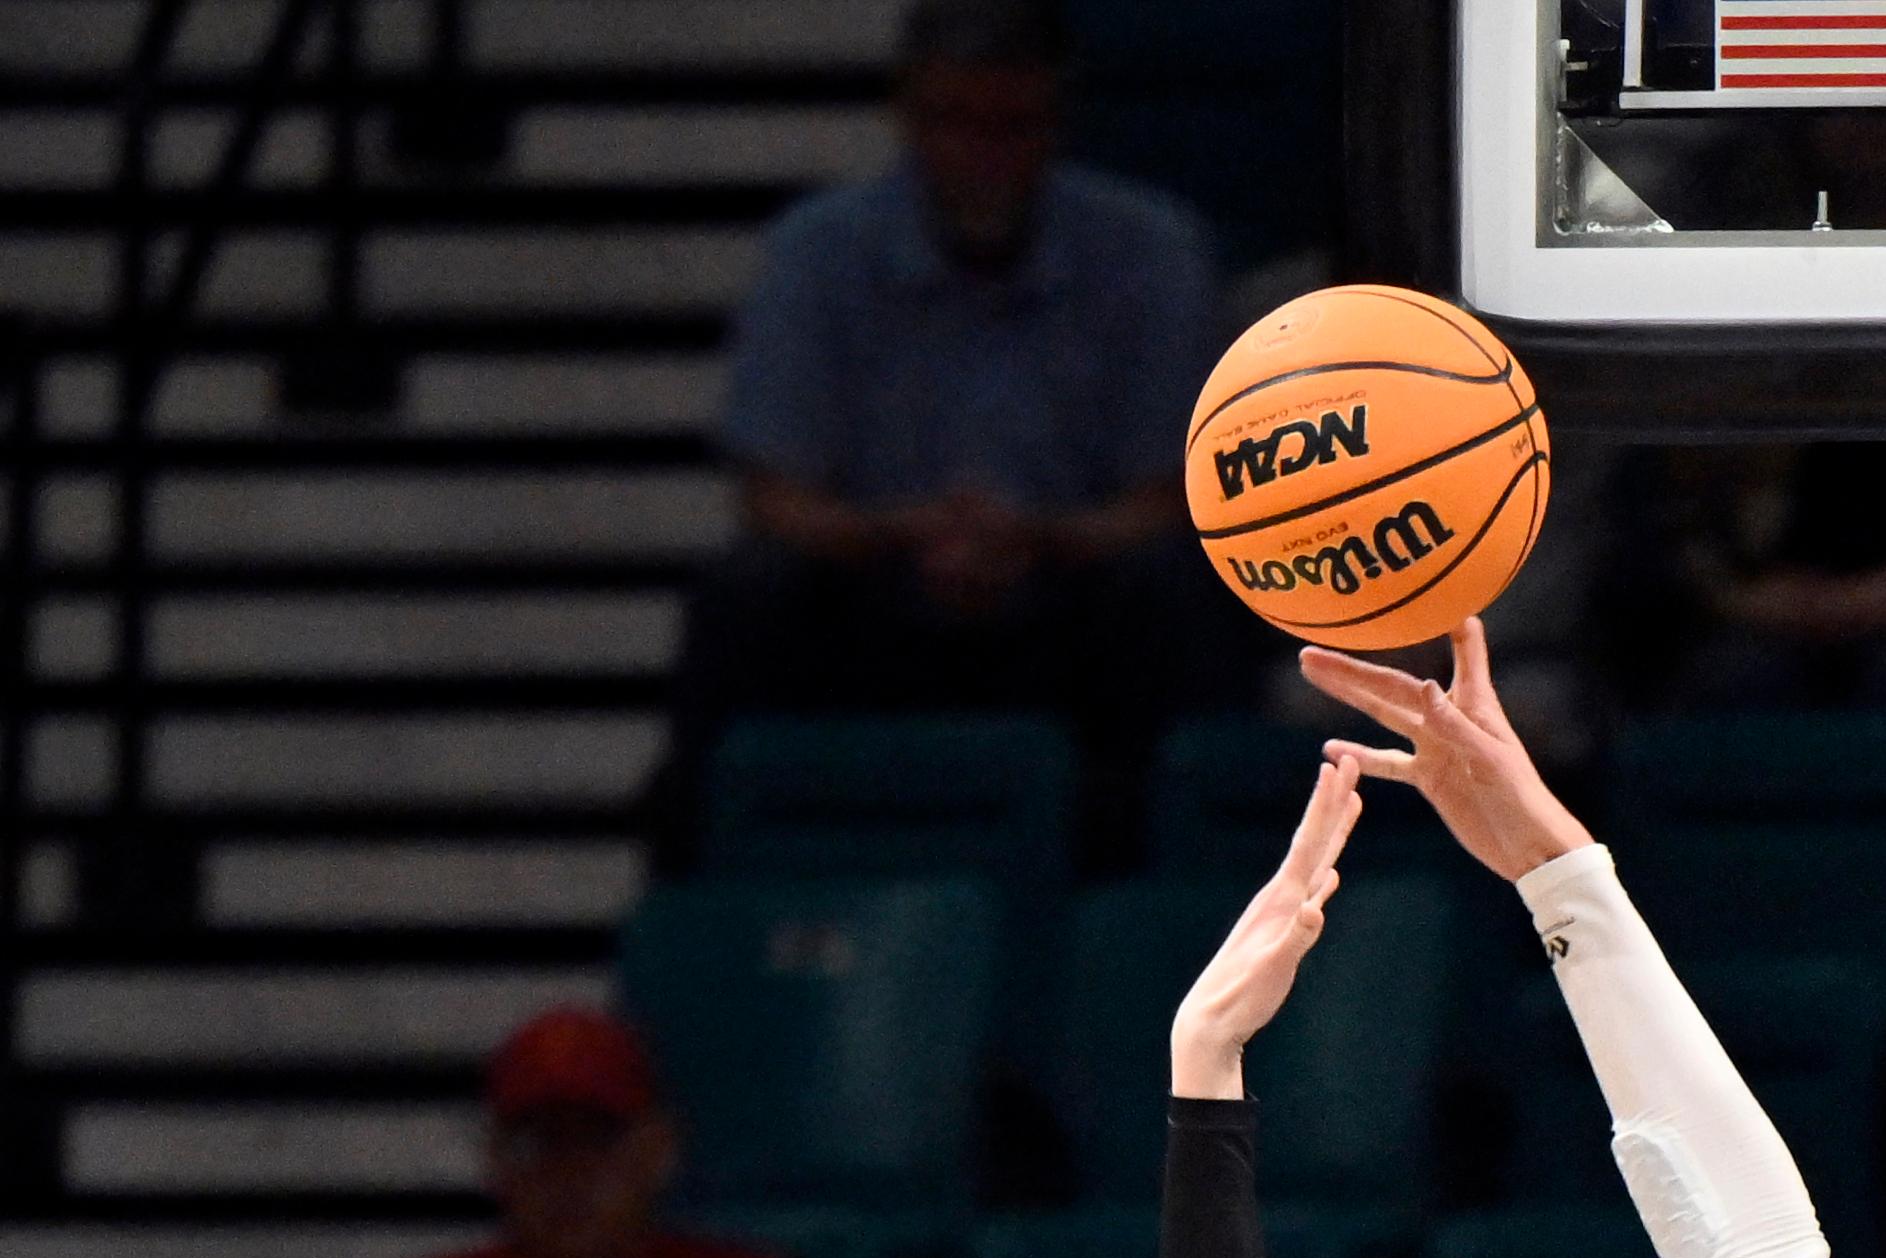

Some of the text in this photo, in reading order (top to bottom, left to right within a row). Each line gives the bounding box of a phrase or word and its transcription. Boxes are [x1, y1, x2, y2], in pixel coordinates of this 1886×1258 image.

[1214, 404, 1370, 501] NCAA
[1227, 500, 1456, 596] Wilson
[1316, 520, 1350, 542] EVO
